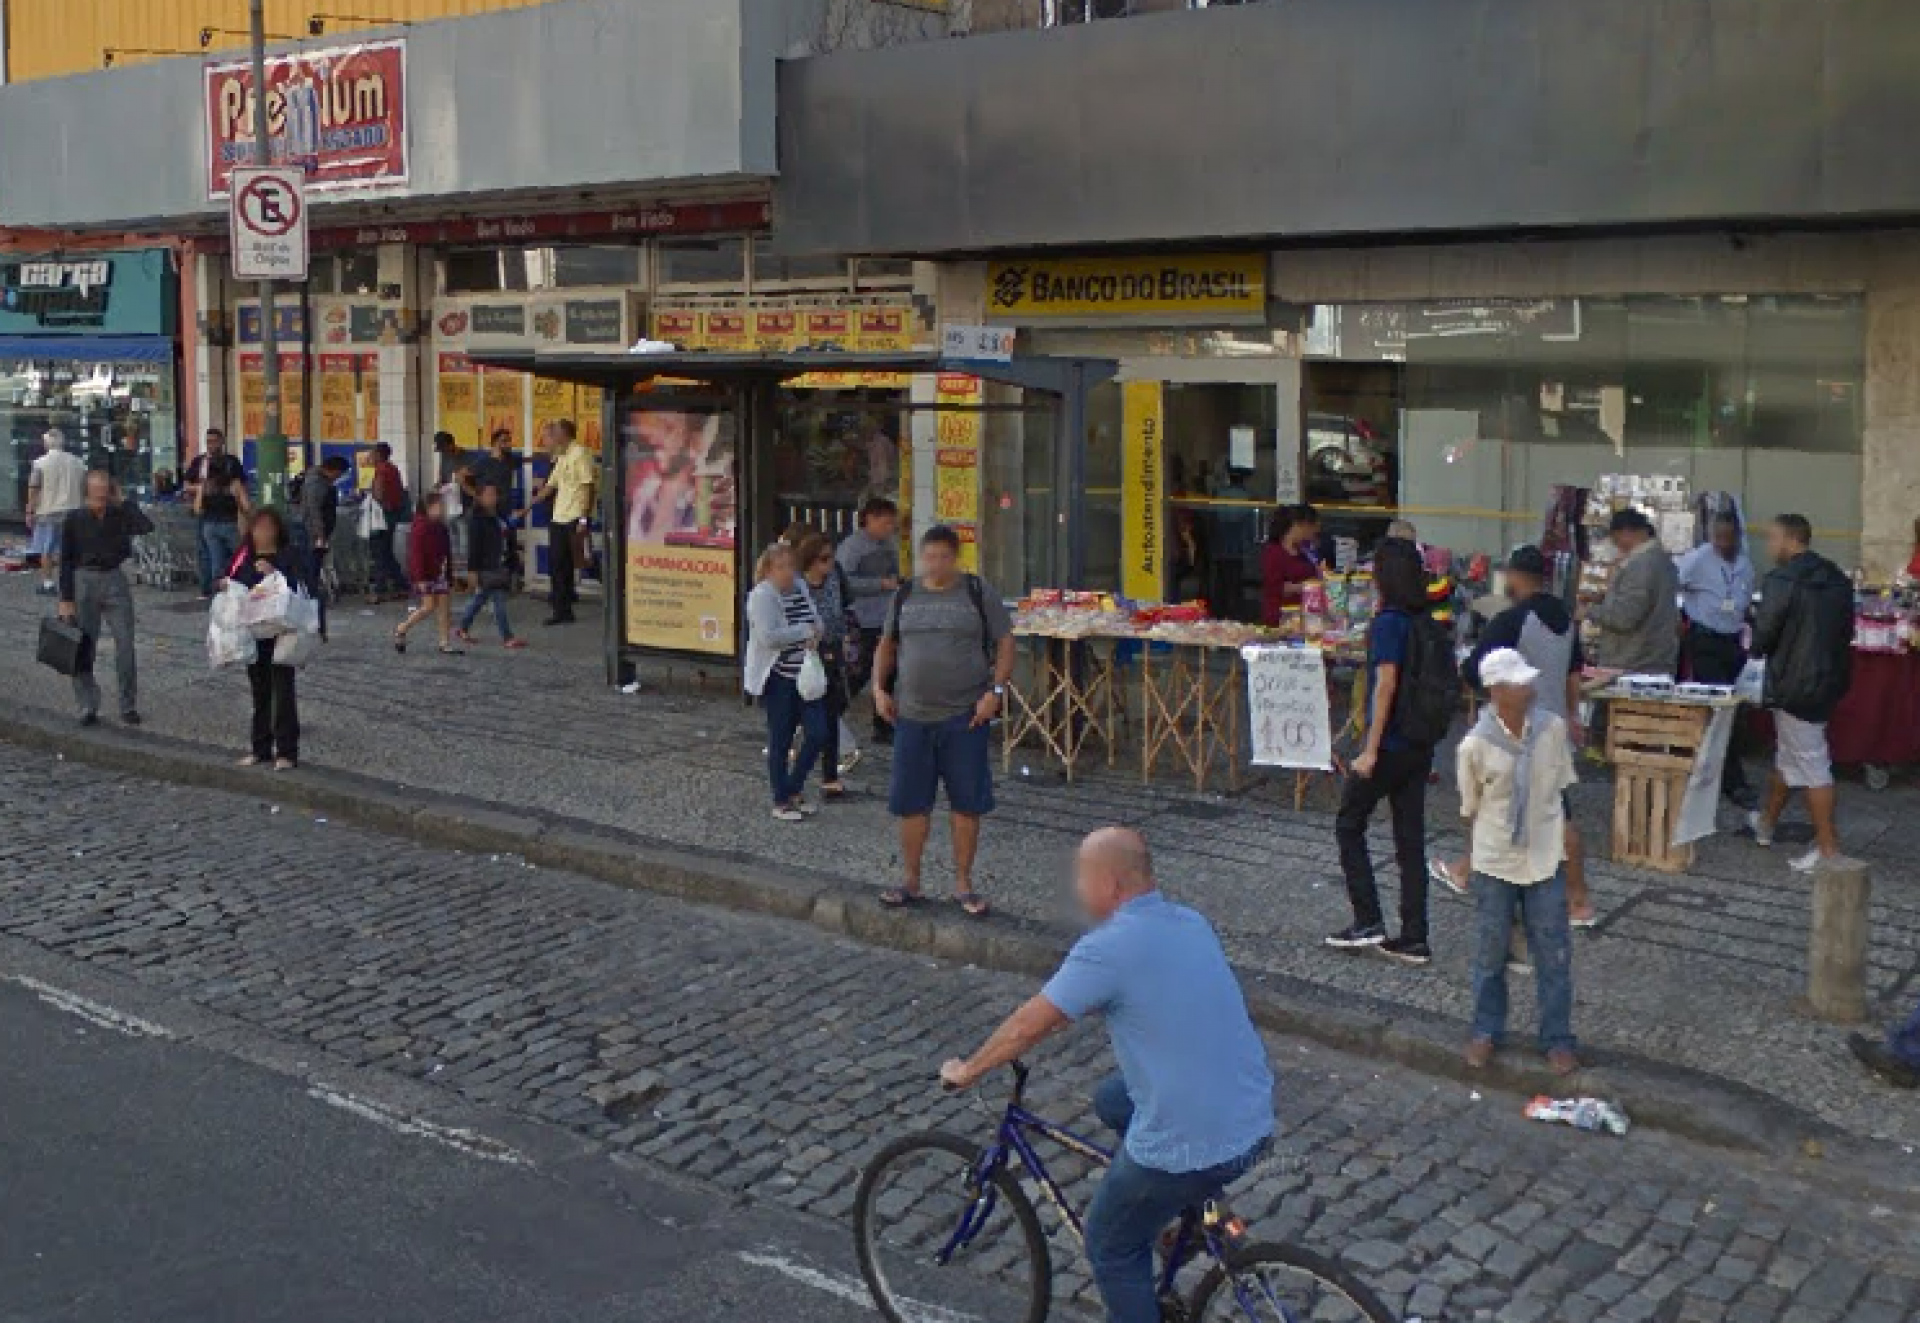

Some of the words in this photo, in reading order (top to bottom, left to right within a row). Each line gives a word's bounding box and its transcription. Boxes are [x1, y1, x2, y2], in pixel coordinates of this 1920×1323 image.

[220, 74, 384, 138] Preium
[1033, 271, 1117, 302] BANCO
[1121, 273, 1153, 301] DO
[1159, 268, 1251, 301] BRASIL
[1140, 417, 1156, 575] Autoatendimento
